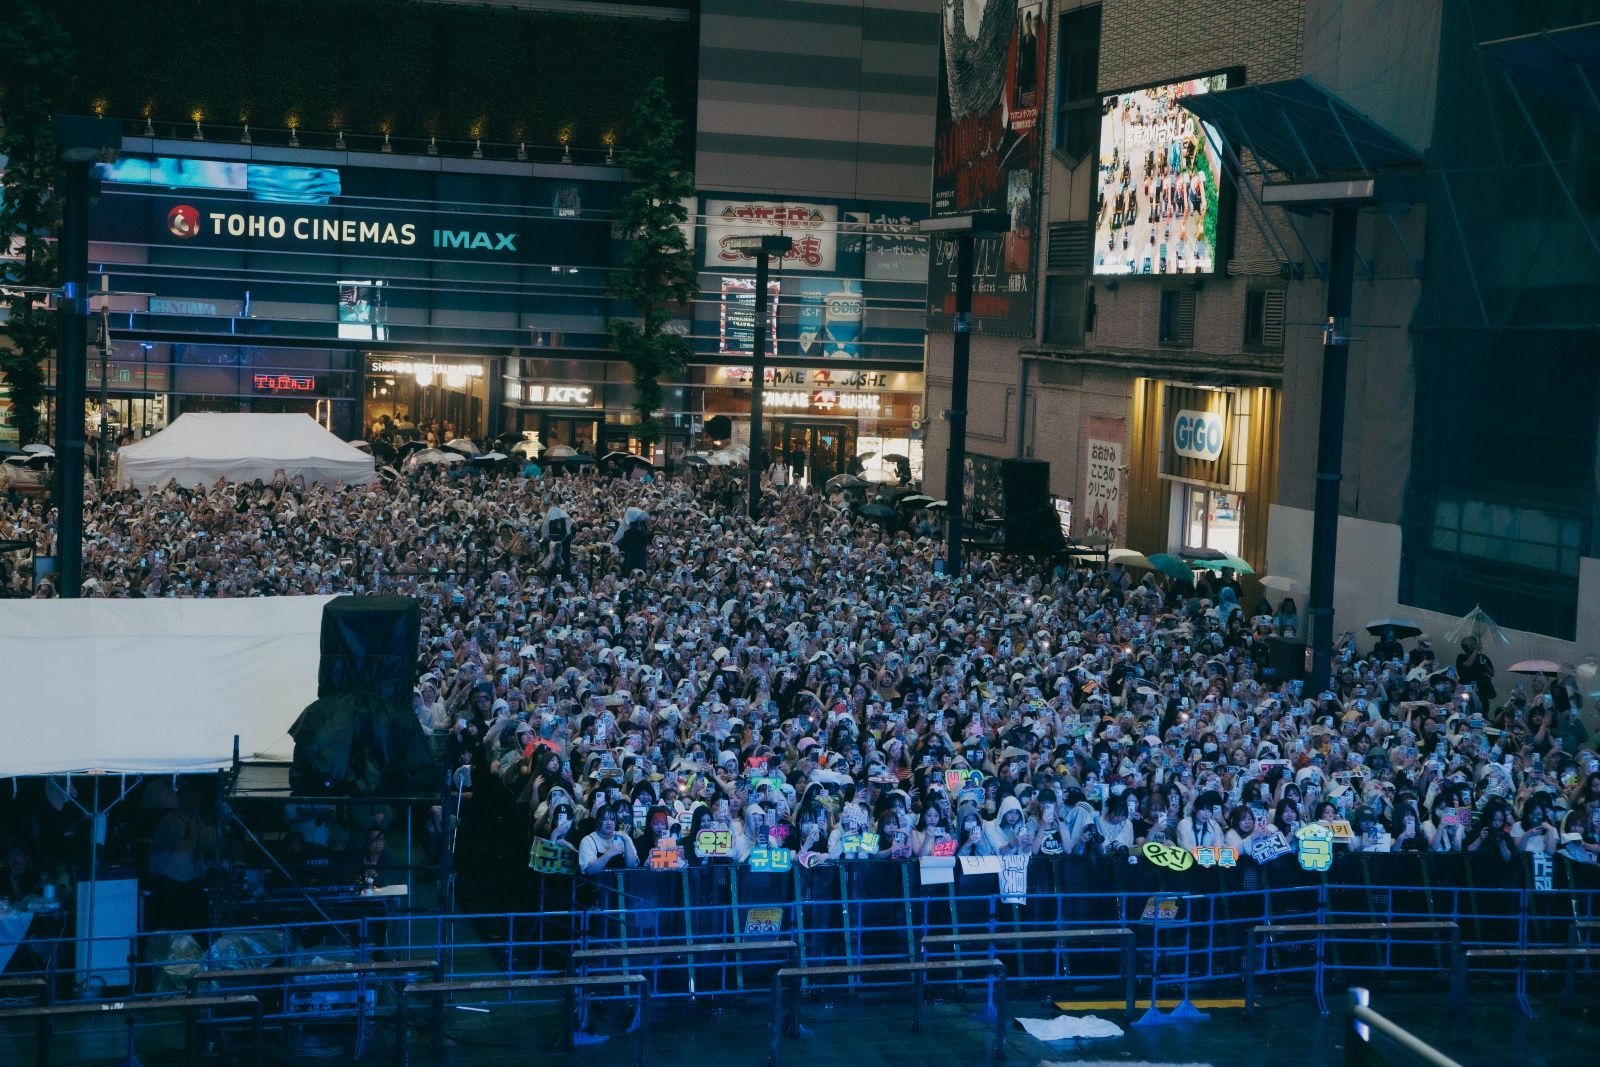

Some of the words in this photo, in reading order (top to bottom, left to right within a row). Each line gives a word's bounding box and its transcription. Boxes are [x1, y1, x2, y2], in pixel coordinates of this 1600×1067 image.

[210, 212, 286, 239] TOHO
[293, 217, 416, 245] CINEMAS
[433, 229, 517, 252] IMAX
[546, 386, 592, 402] KFC
[1175, 415, 1221, 454] GiGO
[1091, 443, 1116, 462] おおかみ
[1091, 463, 1115, 481] こころの
[1088, 482, 1118, 500] クリニック
[699, 830, 733, 854] 유진
[1251, 831, 1287, 863] 유진
[751, 849, 788, 869] 규빈
